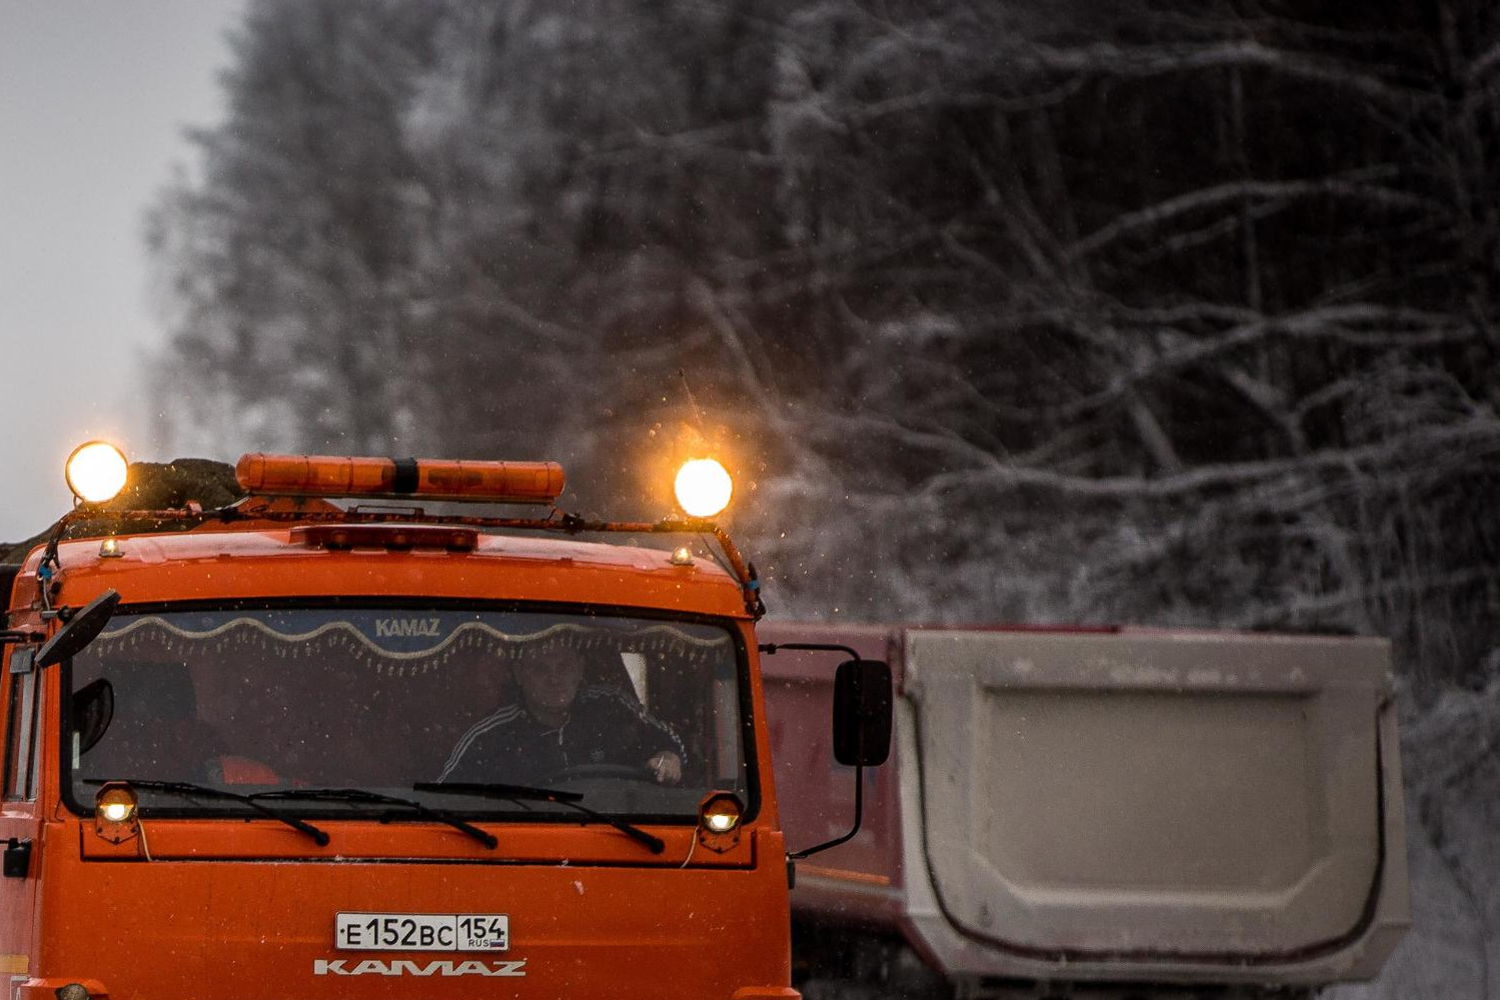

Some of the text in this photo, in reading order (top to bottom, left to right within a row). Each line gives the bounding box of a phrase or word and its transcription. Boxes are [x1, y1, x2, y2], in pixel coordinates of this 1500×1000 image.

[376, 618, 440, 637] KAMAZ
[460, 918, 504, 939] 154
[468, 939, 489, 948] RUS
[314, 959, 526, 976] KAMAZ
